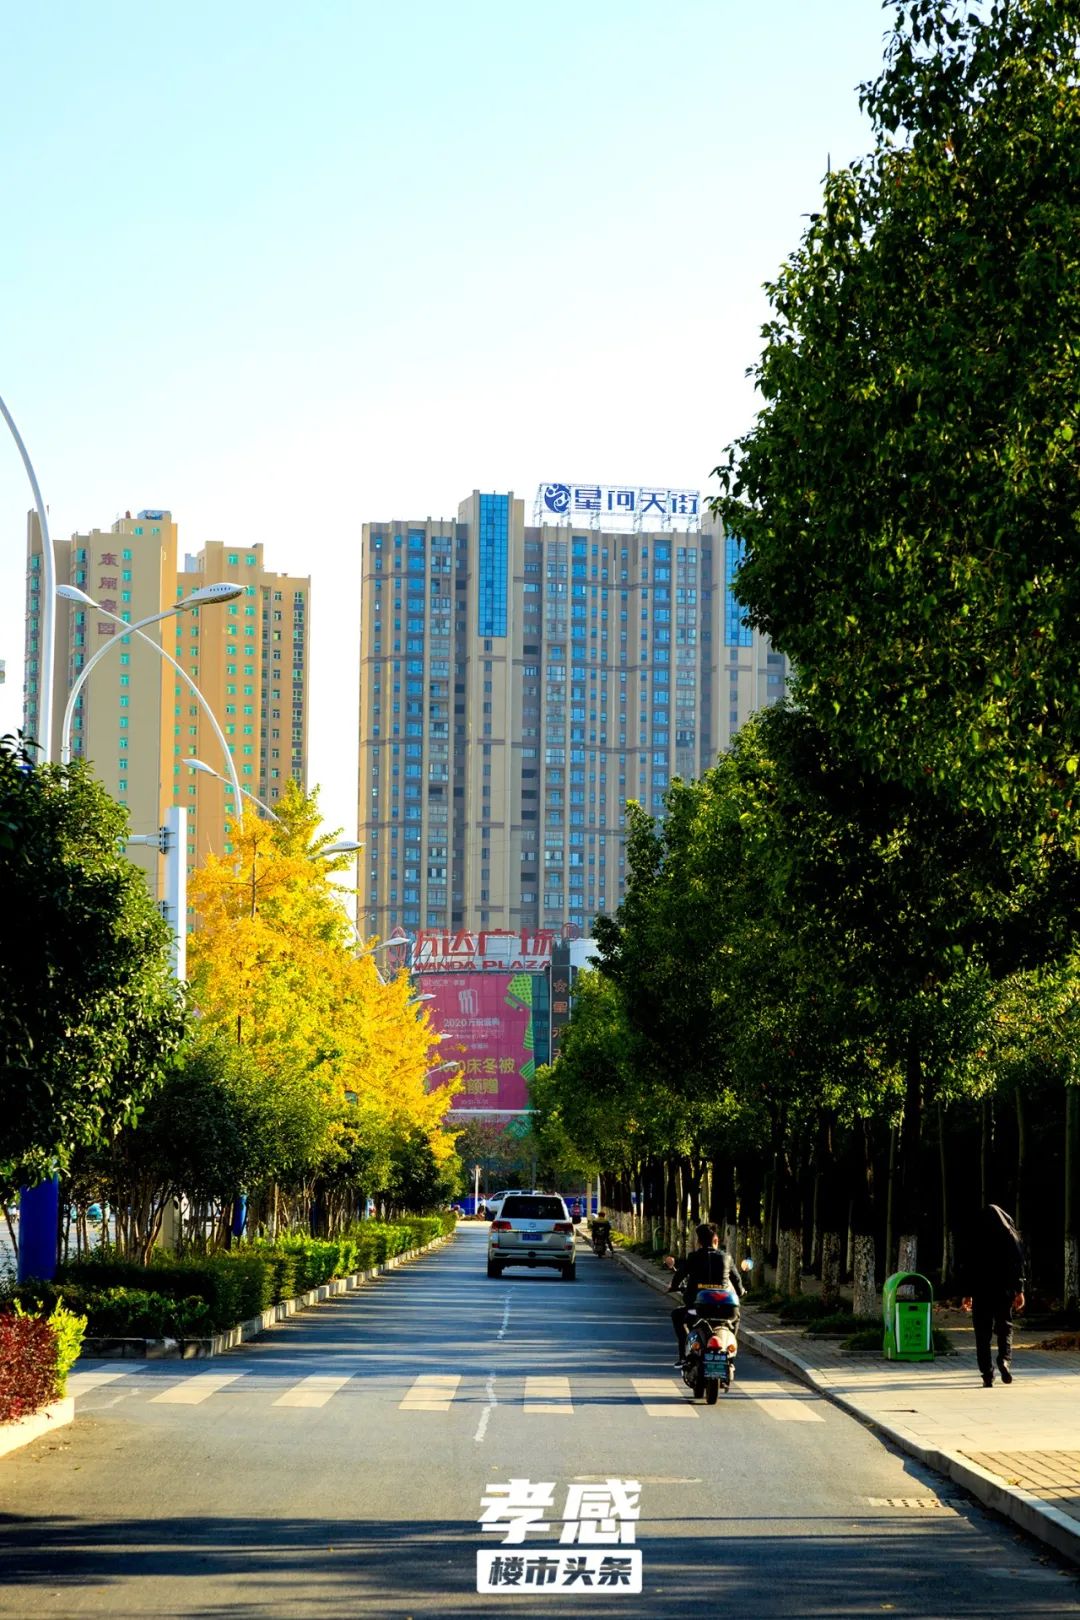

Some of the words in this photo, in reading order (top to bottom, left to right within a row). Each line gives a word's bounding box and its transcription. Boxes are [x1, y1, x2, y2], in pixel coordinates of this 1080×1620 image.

[414, 928, 556, 957] 万达广场
[415, 961, 477, 971] WANDA
